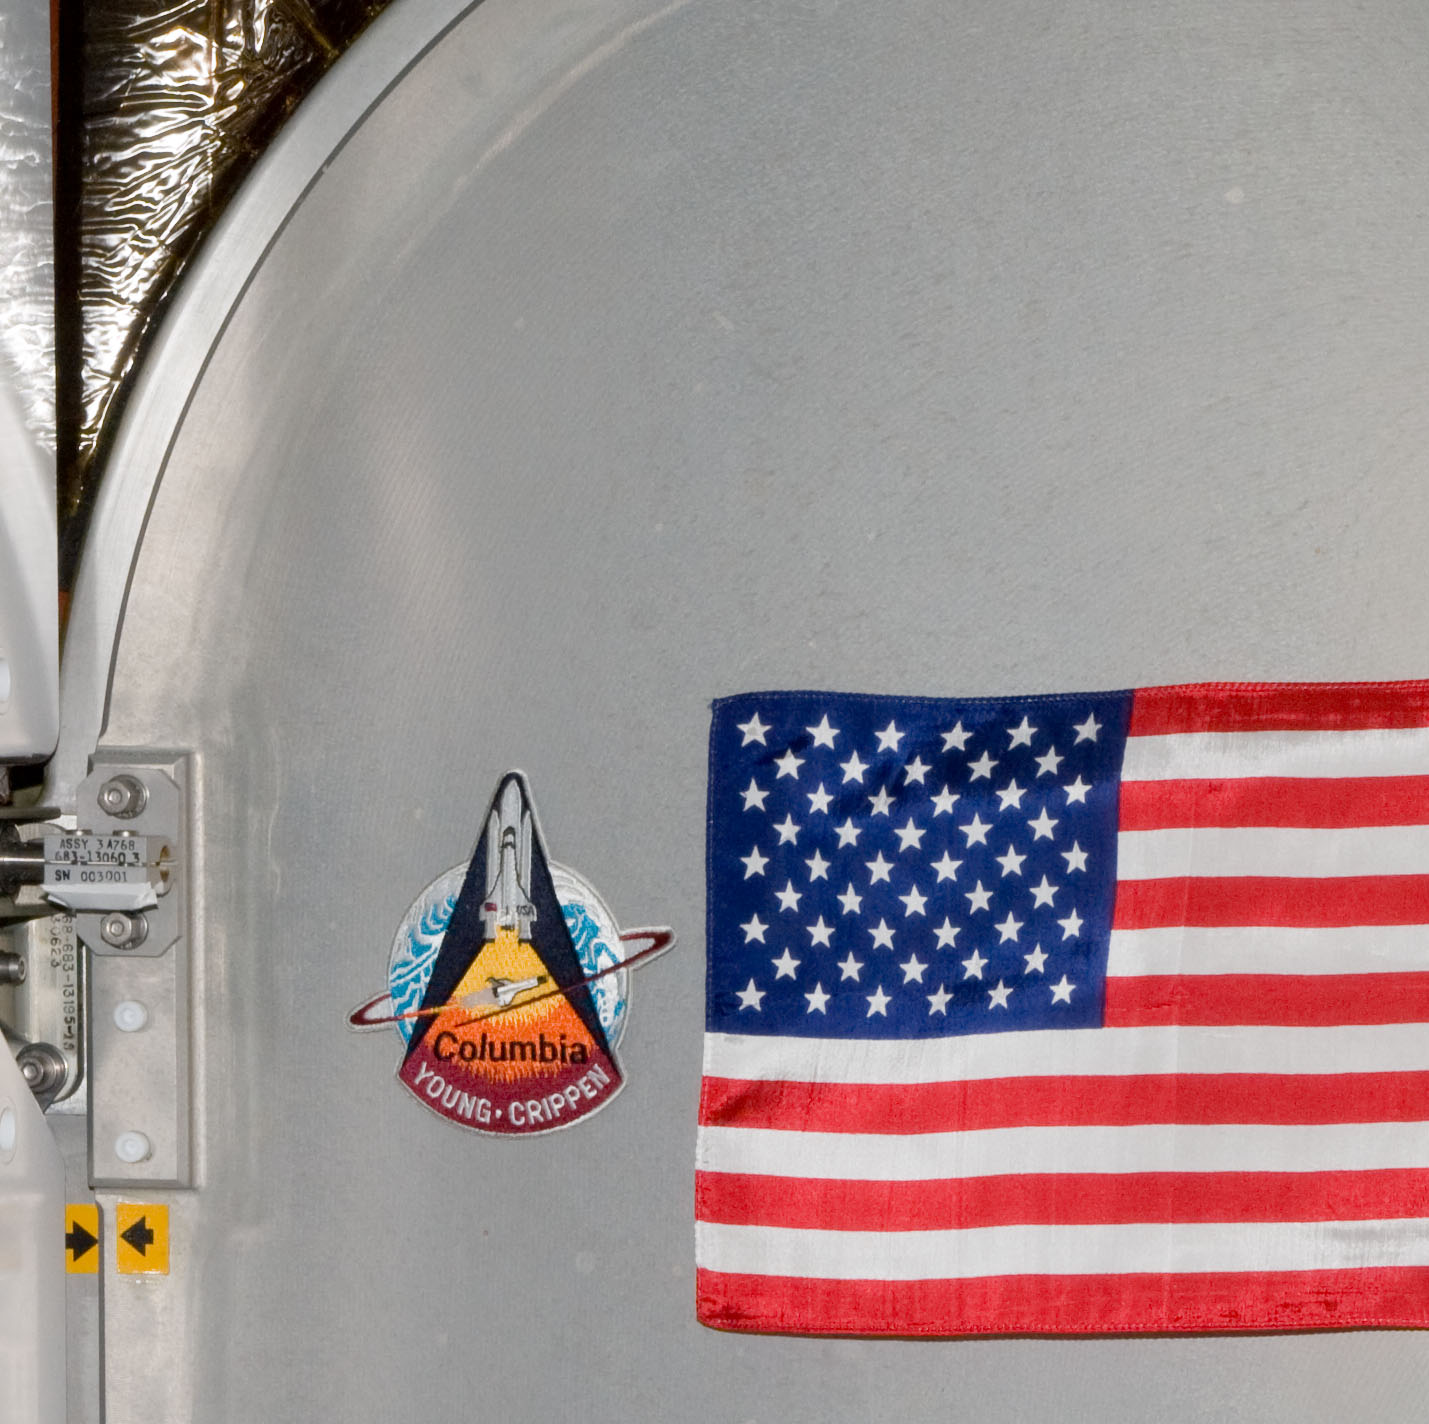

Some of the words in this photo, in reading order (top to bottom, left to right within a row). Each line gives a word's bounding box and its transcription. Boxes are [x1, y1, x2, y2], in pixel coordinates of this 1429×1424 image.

[60, 839, 88, 850] ASSY
[55, 869, 71, 882] SN
[432, 1031, 588, 1064] Columbia
[413, 1062, 492, 1124] YOUNG
[509, 1063, 612, 1126] CRIPPEN
